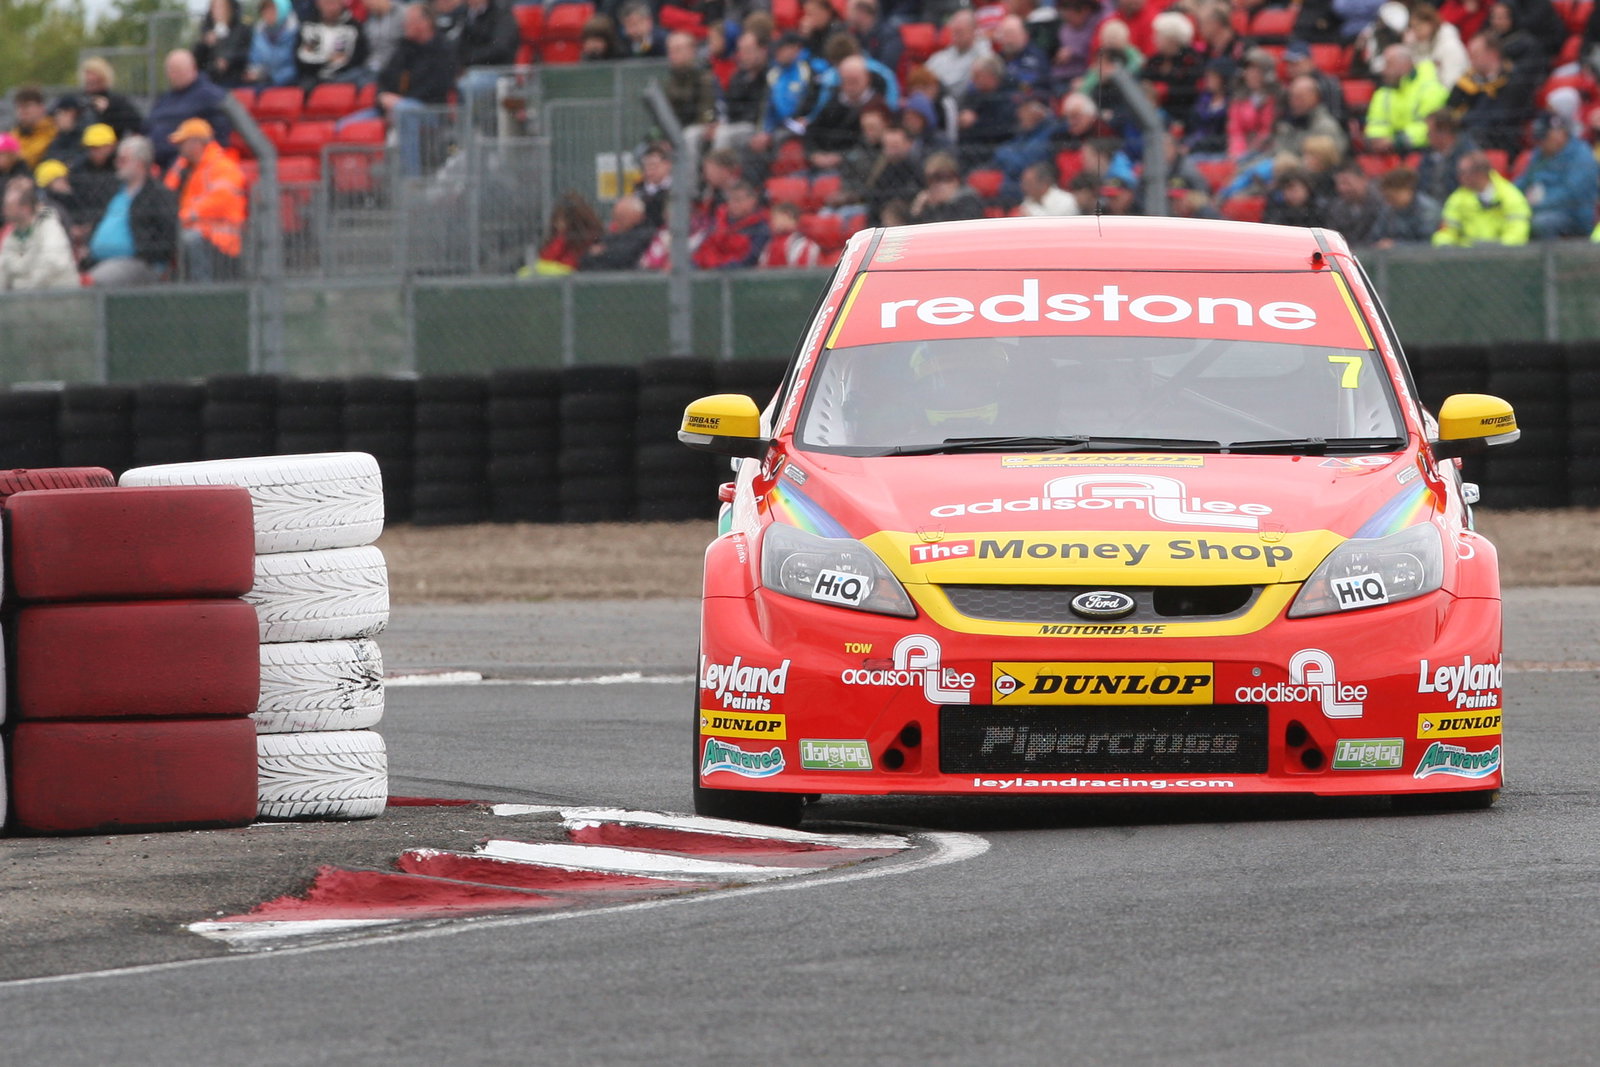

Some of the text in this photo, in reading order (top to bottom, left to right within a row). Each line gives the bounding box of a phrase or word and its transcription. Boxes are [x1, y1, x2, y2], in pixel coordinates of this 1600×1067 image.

[880, 278, 1317, 331] redstone
[1327, 355, 1363, 389] 7
[929, 496, 1274, 518] addison lee
[913, 539, 1294, 568] The Money Shop
[815, 572, 862, 601] HiQ
[1335, 577, 1386, 604] HiQ
[1085, 595, 1120, 610] Ford
[1039, 624, 1167, 635] MOTORBASE
[844, 642, 873, 654] TOW
[700, 654, 791, 700] Leyland
[841, 667, 976, 688] addison lee
[1028, 674, 1212, 695] DUNLOP
[1418, 652, 1503, 702] Leyland
[722, 691, 771, 711] Paints
[1235, 681, 1368, 702] addison lee
[1455, 690, 1498, 709] Paints
[711, 717, 782, 732] DUNLOP
[1437, 715, 1501, 731] DUNLOP
[702, 738, 783, 770] Airwaves
[1415, 741, 1500, 776] Airwaves
[973, 777, 1235, 789] leylandracing.com
